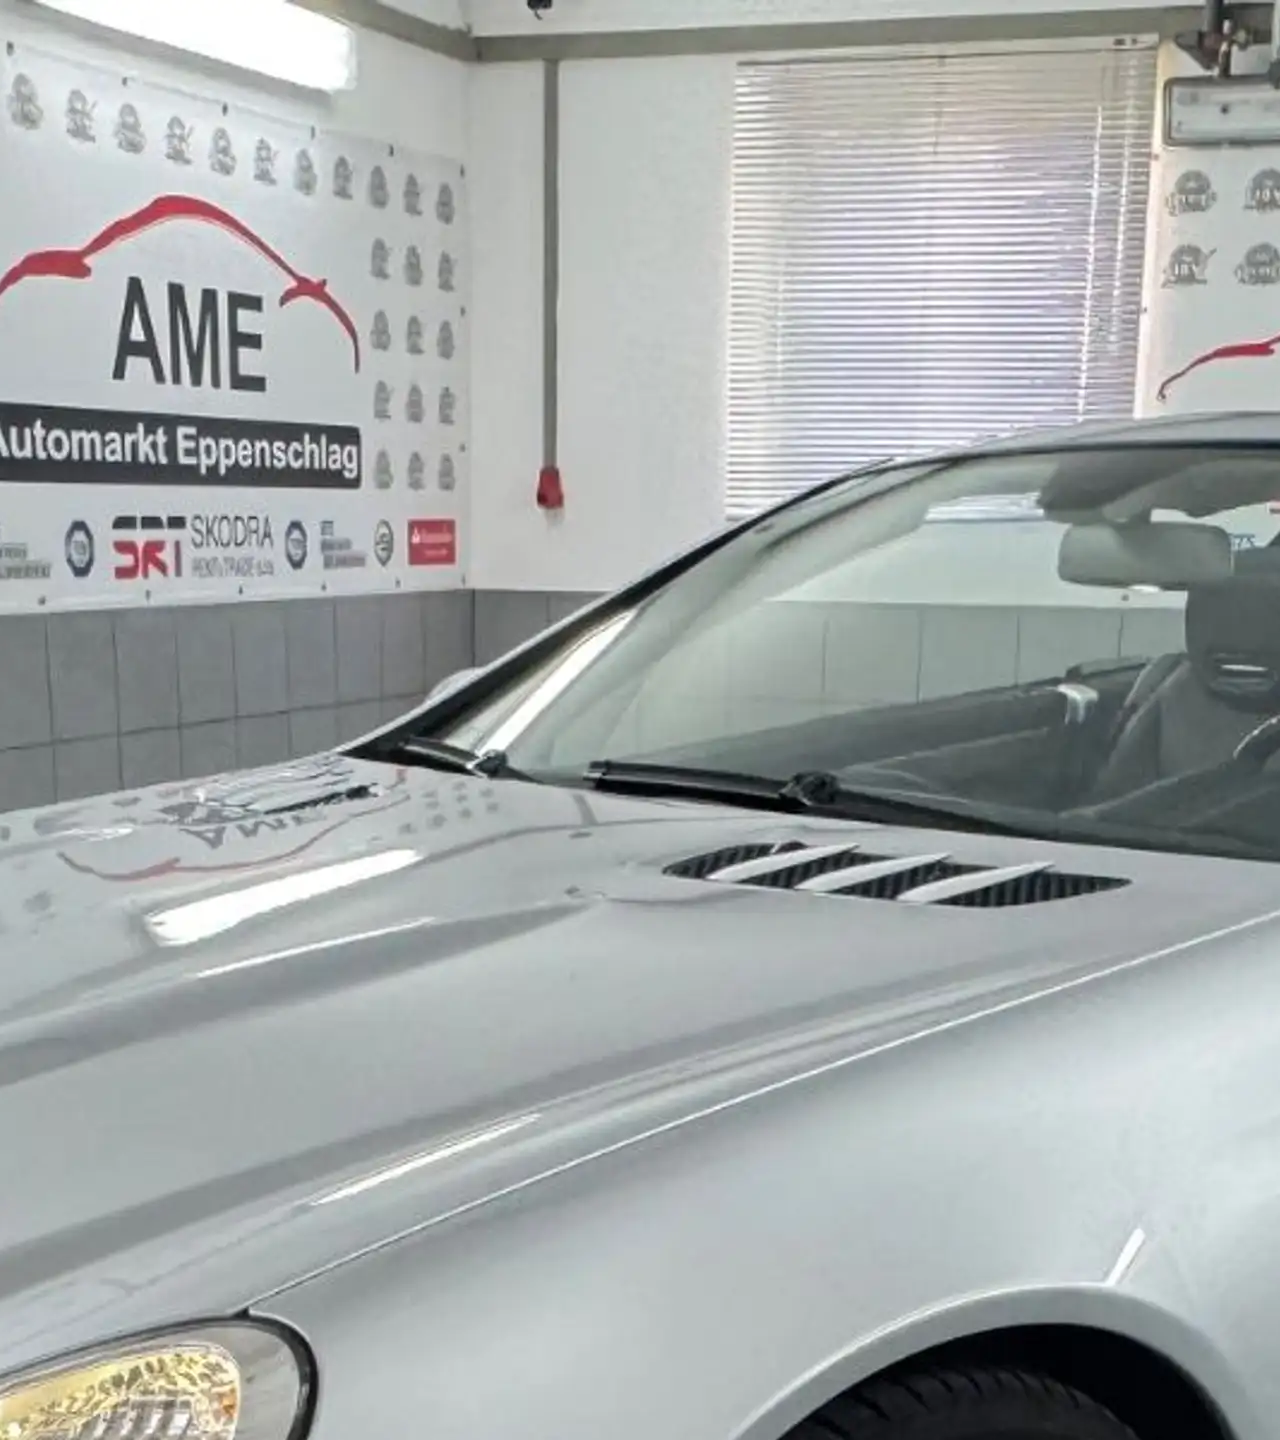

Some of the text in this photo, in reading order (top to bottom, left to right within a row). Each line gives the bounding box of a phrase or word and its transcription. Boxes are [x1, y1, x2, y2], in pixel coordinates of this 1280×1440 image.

[111, 275, 268, 393] AME
[176, 426, 359, 480] Eppenschlag
[190, 514, 275, 550] SKODRA
